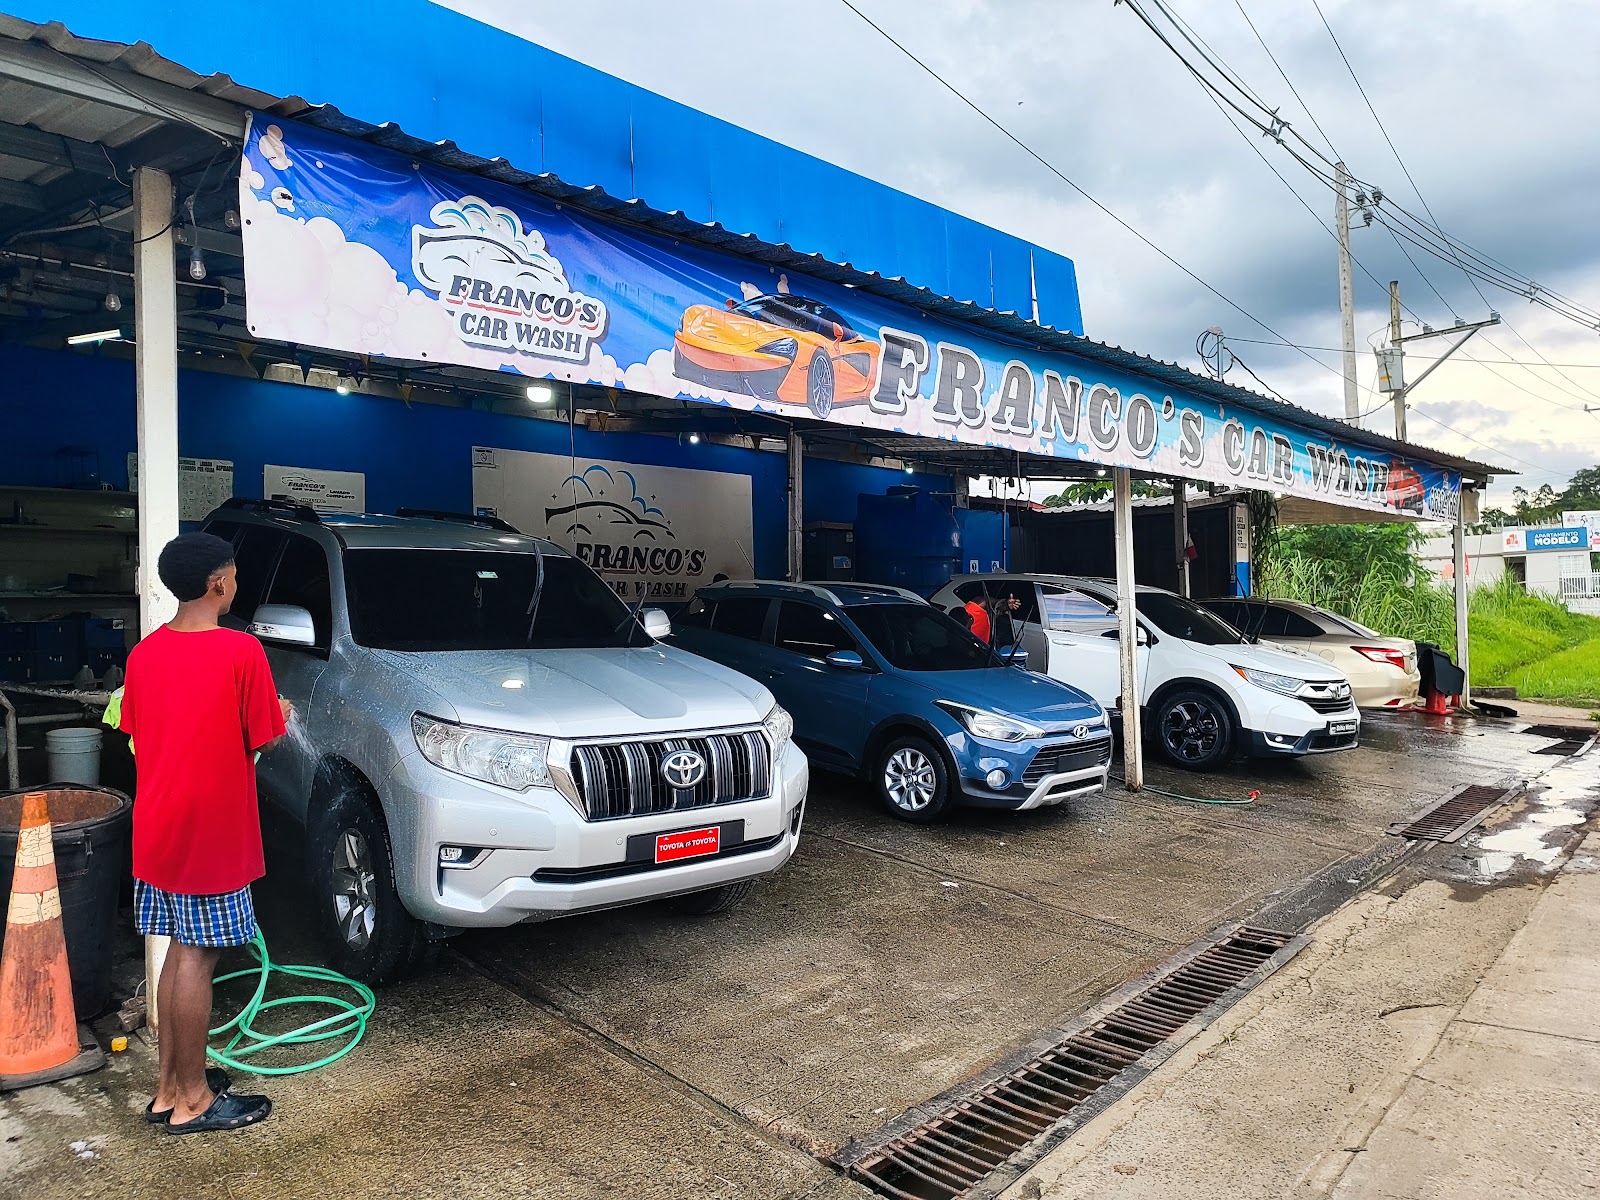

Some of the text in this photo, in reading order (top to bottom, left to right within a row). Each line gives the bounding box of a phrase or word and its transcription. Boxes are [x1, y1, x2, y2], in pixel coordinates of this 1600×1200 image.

[447, 275, 600, 328] FRANCO'S
[460, 312, 583, 354] CAR WASH
[870, 327, 1391, 507] FRANCO'S CAR WASH
[287, 482, 326, 490] FRANCO'S
[1534, 531, 1579, 539] APARTAMENTO
[1534, 536, 1579, 546] MODELO
[575, 543, 706, 575] FRANCO'S
[659, 842, 684, 852] TOYOTA
[692, 837, 716, 847] TOYOTA
